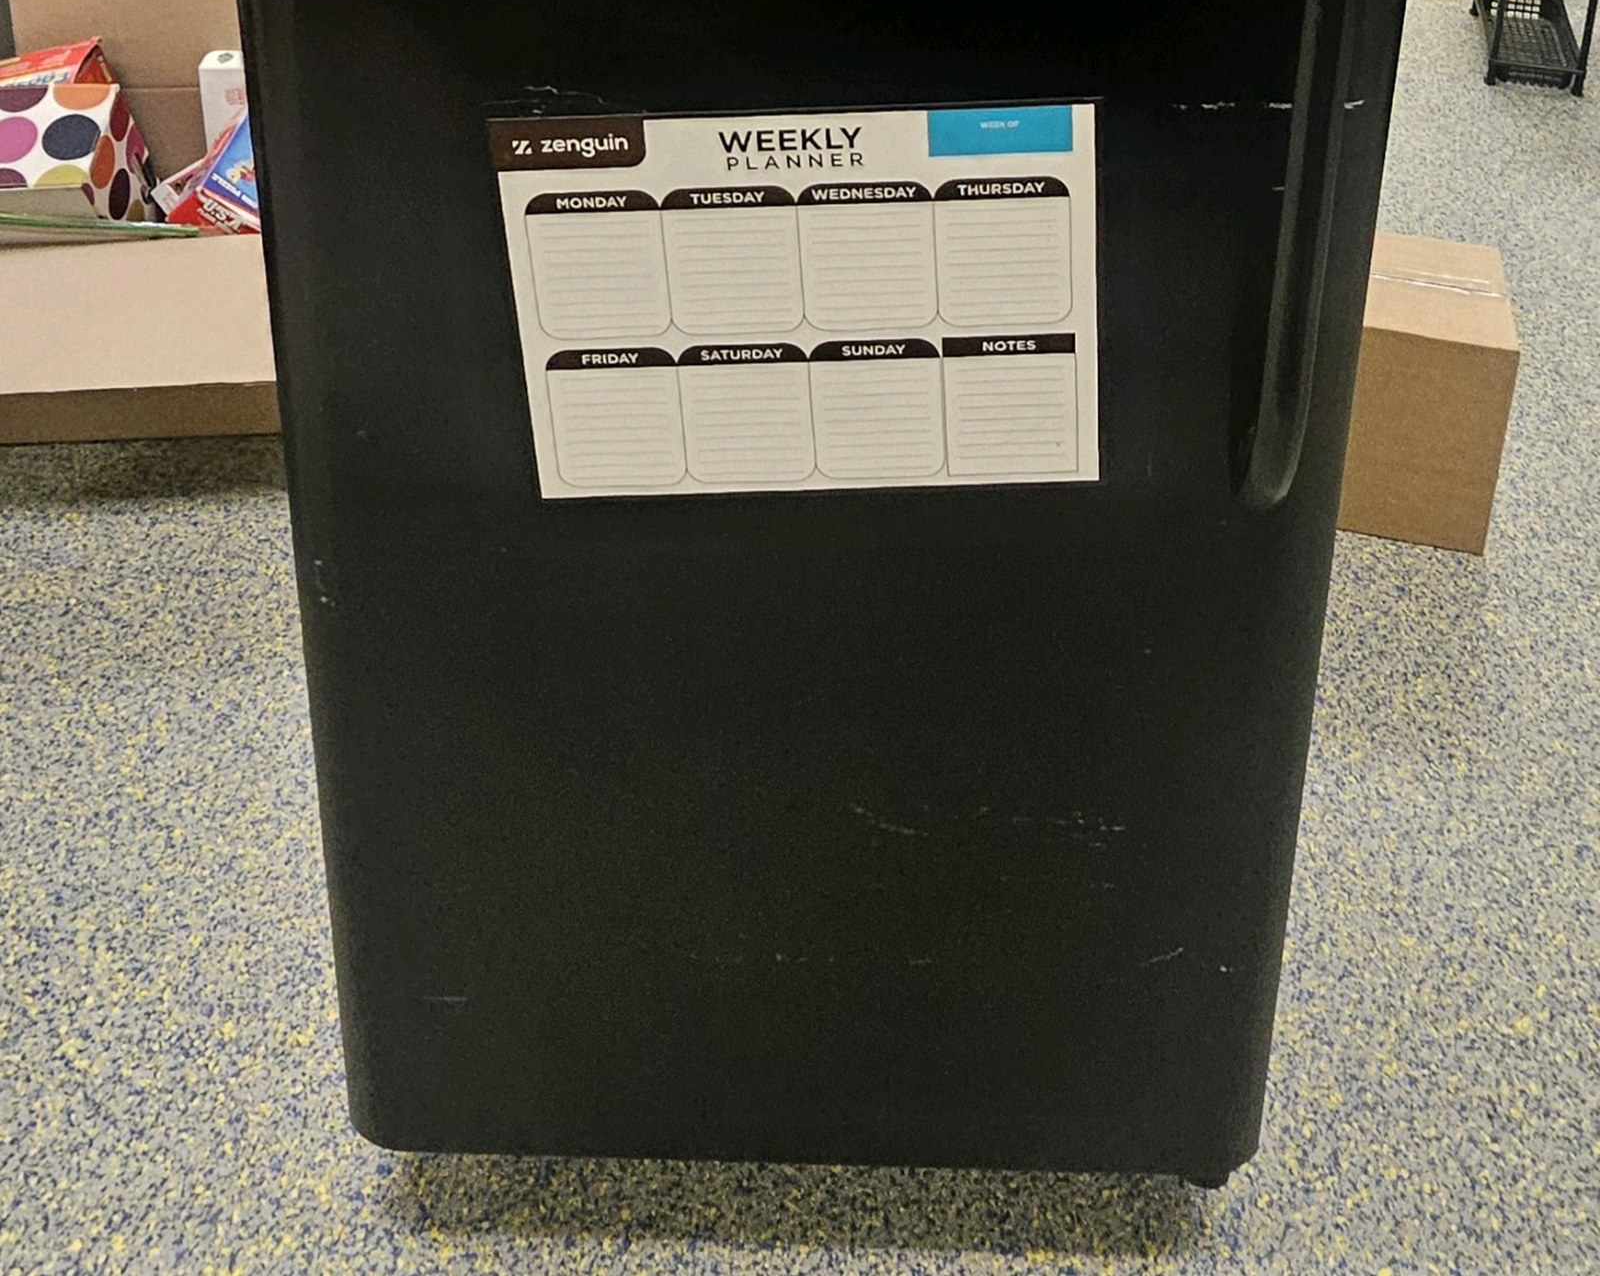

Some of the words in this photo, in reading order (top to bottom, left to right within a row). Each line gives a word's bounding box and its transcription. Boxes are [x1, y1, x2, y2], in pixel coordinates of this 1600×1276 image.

[980, 120, 1006, 129] WEEK
[1007, 120, 1020, 128] OF
[541, 133, 629, 158] zenguin
[718, 126, 863, 154] WEEKLY
[727, 152, 864, 171] PLANNER
[812, 185, 916, 201] WEDNESDAY
[957, 181, 1045, 196] THURSDAY
[556, 195, 627, 210] MONDAY
[690, 191, 765, 205] TUESDAY
[842, 342, 905, 357] SUNDAY
[982, 338, 1036, 352] NOTES
[581, 351, 639, 366] FRIDAY
[700, 348, 783, 362] SATURDAY
